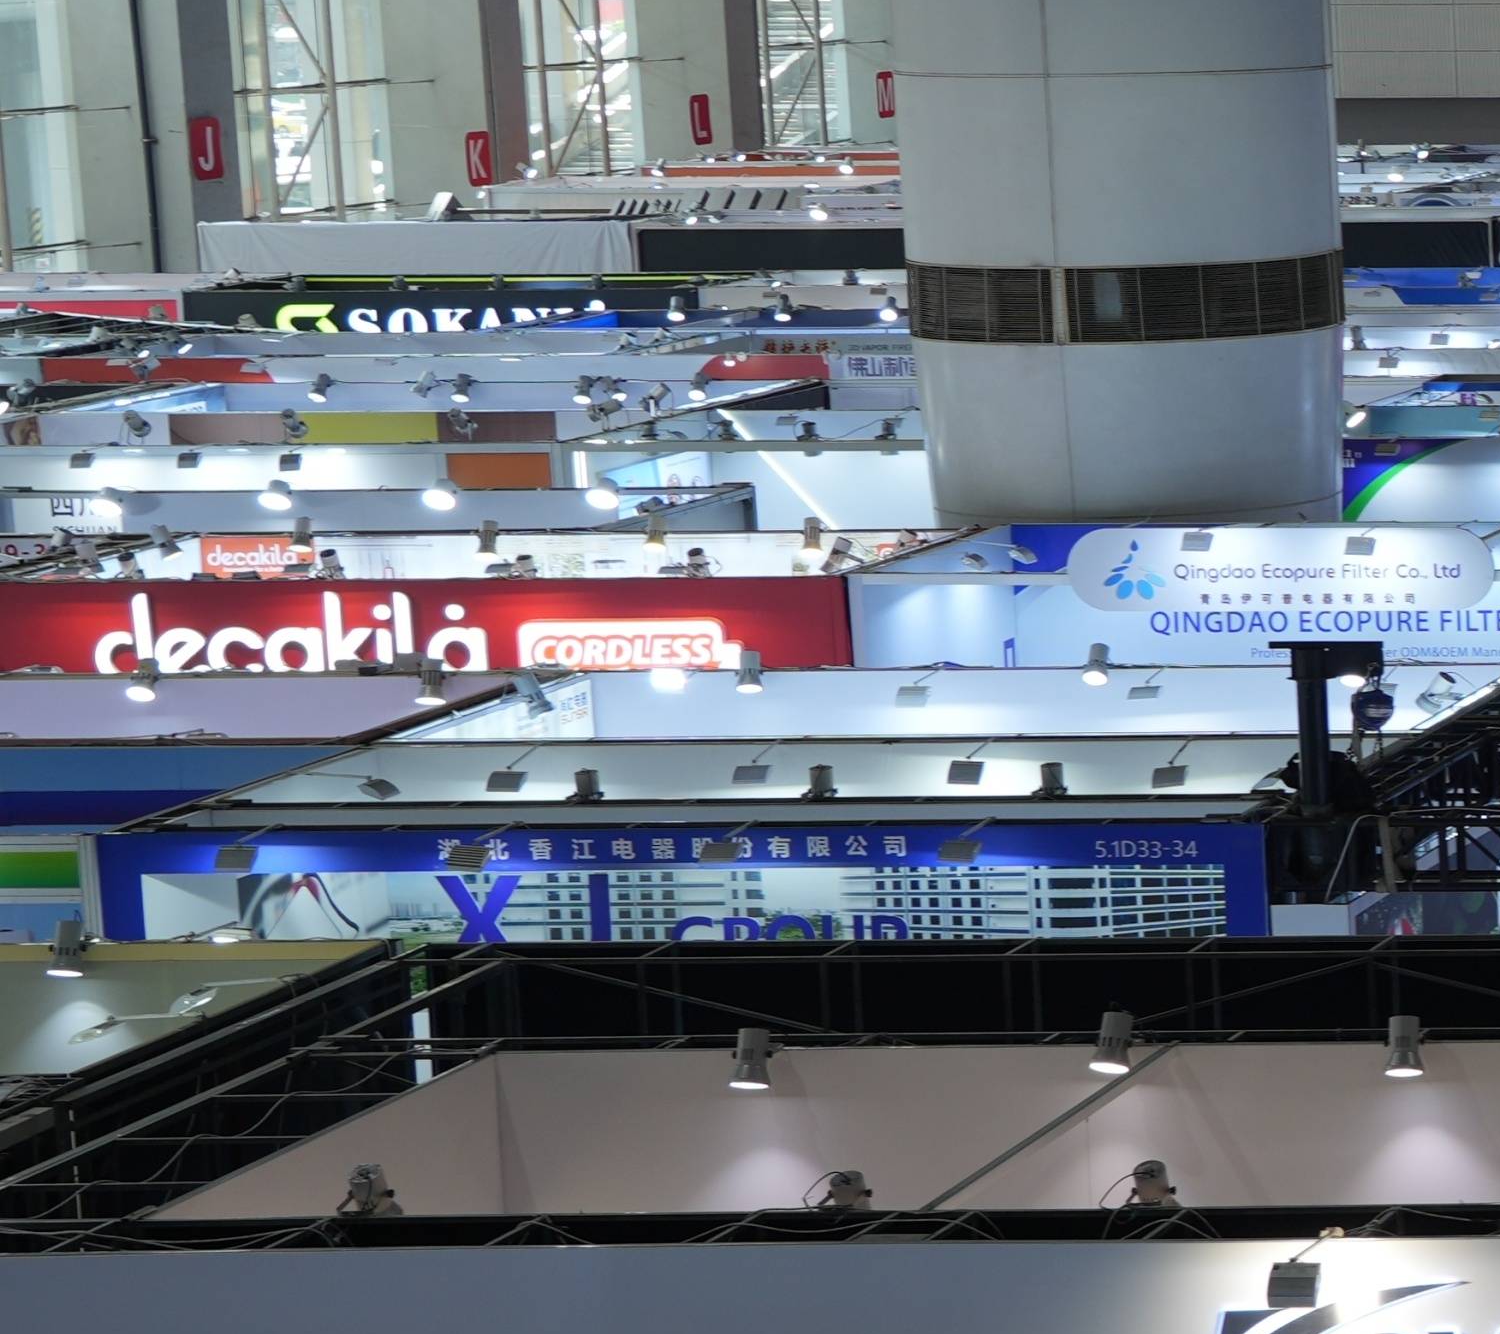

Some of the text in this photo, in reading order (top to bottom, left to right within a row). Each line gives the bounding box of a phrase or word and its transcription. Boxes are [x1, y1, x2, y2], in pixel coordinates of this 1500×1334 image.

[1173, 562, 1256, 582] Qingdao
[1261, 562, 1336, 582] Ecopure
[1341, 562, 1389, 579] Filter
[1433, 562, 1461, 579] Ltd
[94, 592, 490, 673] decakila
[1149, 611, 1289, 635] QINGDAO
[1299, 610, 1429, 633] ECOPURE
[534, 633, 716, 668] CORDLESS
[1094, 839, 1199, 860] 5.1D33-34
